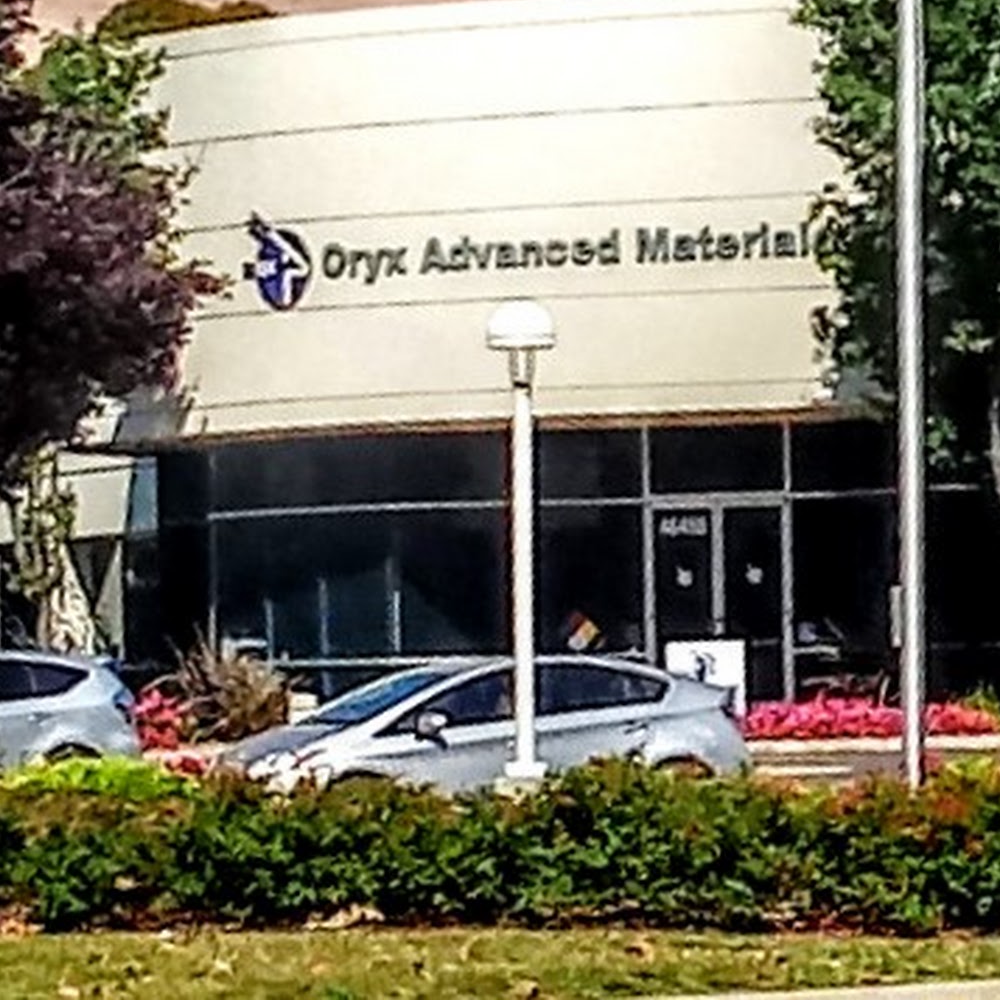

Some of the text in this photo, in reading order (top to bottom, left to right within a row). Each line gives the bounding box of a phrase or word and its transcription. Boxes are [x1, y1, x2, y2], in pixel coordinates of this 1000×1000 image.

[322, 221, 810, 284] Oryx Advanced Material
